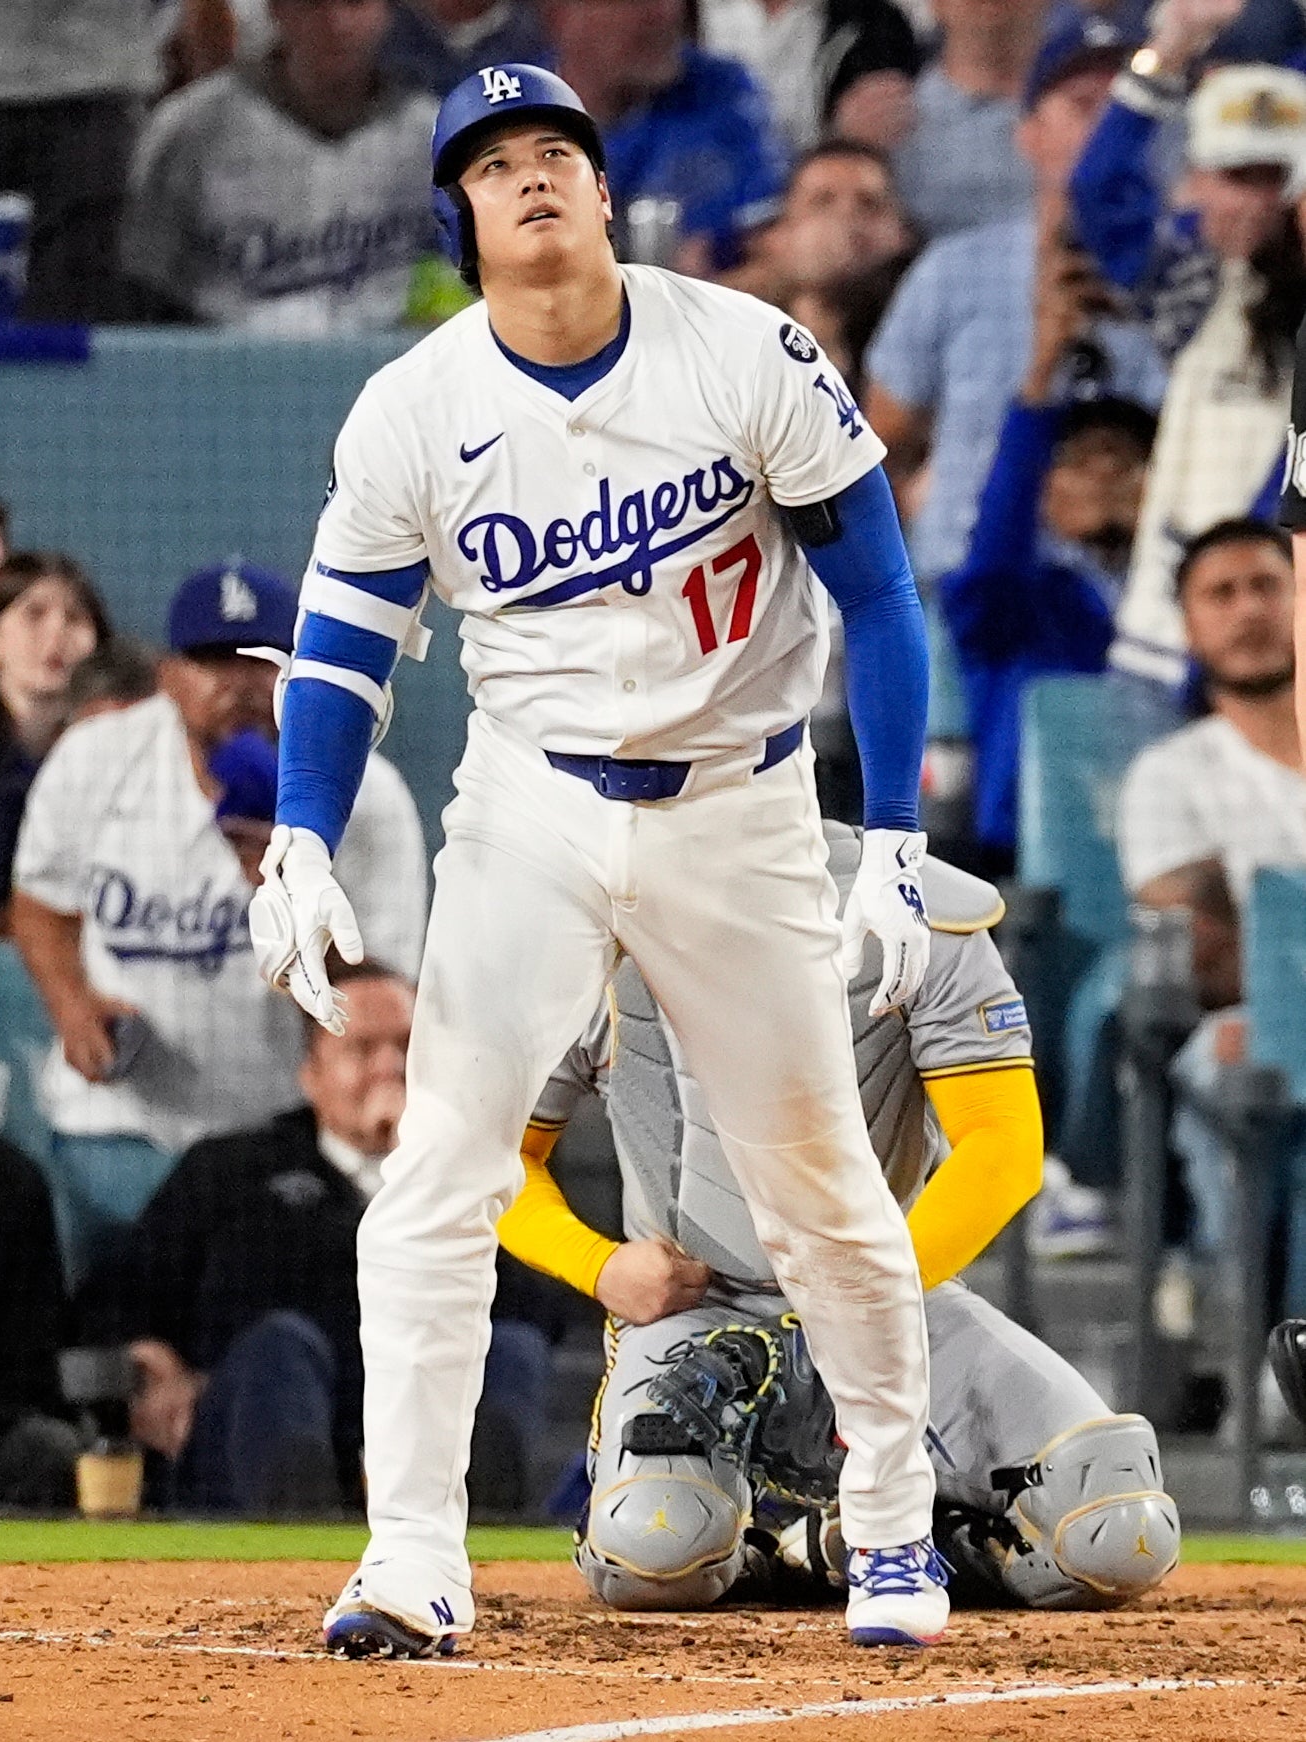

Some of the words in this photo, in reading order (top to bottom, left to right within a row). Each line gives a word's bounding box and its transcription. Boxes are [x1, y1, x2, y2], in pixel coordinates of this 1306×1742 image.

[477, 66, 522, 104] LA
[813, 373, 864, 440] LA
[457, 456, 755, 608] Dodgers
[681, 532, 763, 656] 17
